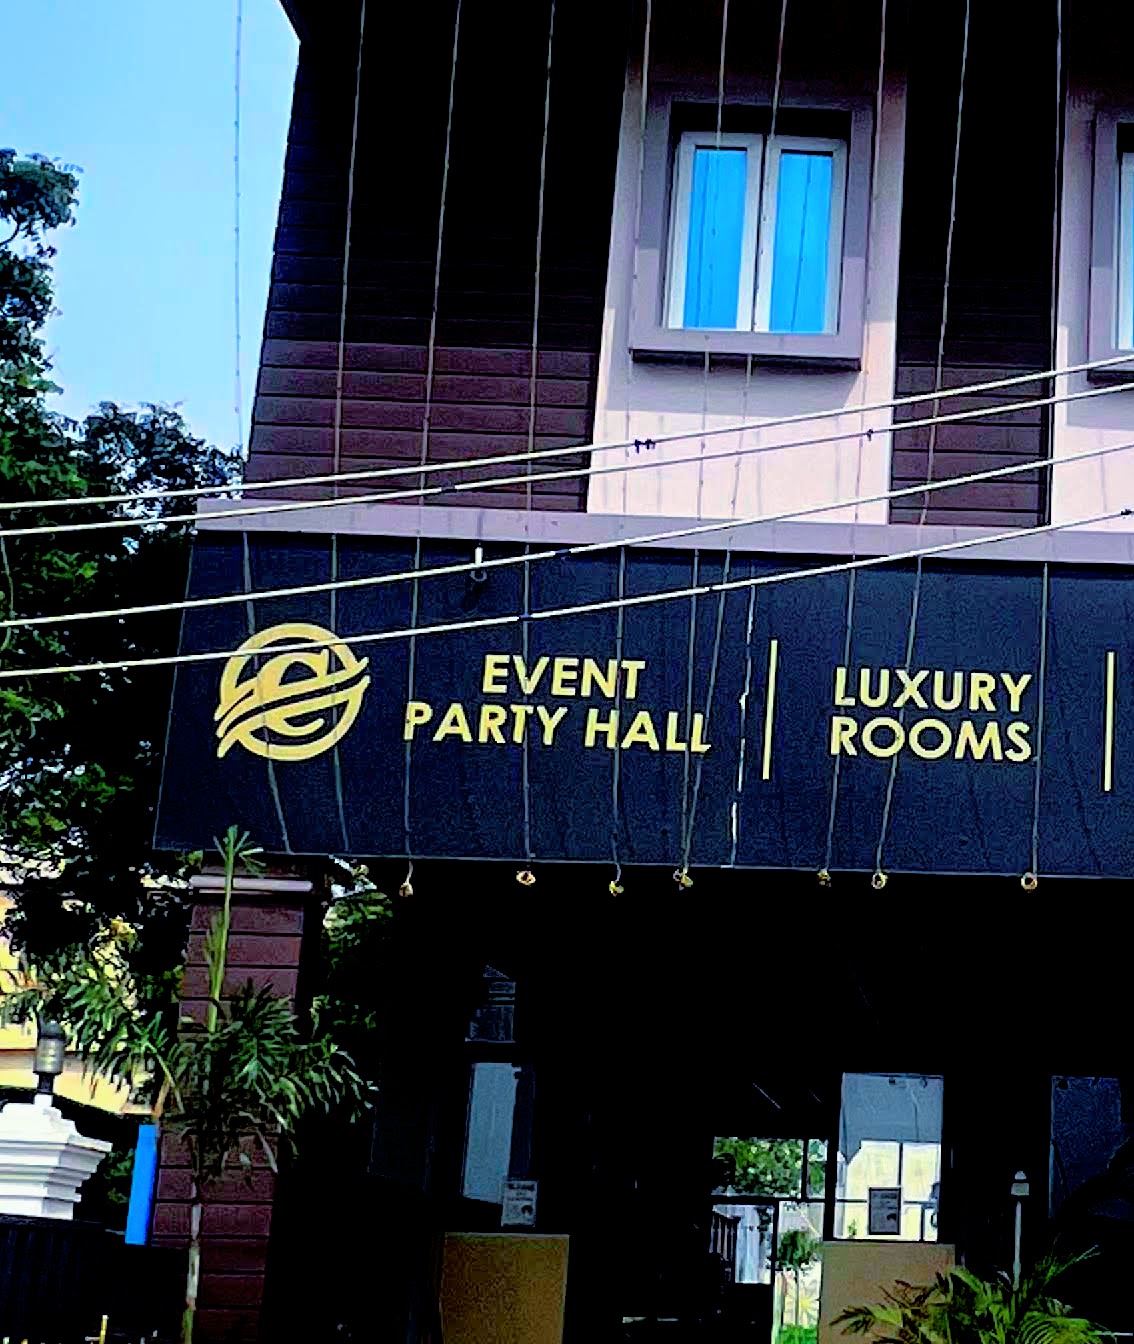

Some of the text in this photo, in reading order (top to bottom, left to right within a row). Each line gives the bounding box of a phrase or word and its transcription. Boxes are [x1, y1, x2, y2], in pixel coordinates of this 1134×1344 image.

[481, 654, 646, 699] EVENT
[833, 666, 1033, 713] LUXURY
[403, 701, 711, 753] PARTY HALL
[829, 716, 1033, 763] ROOMS
